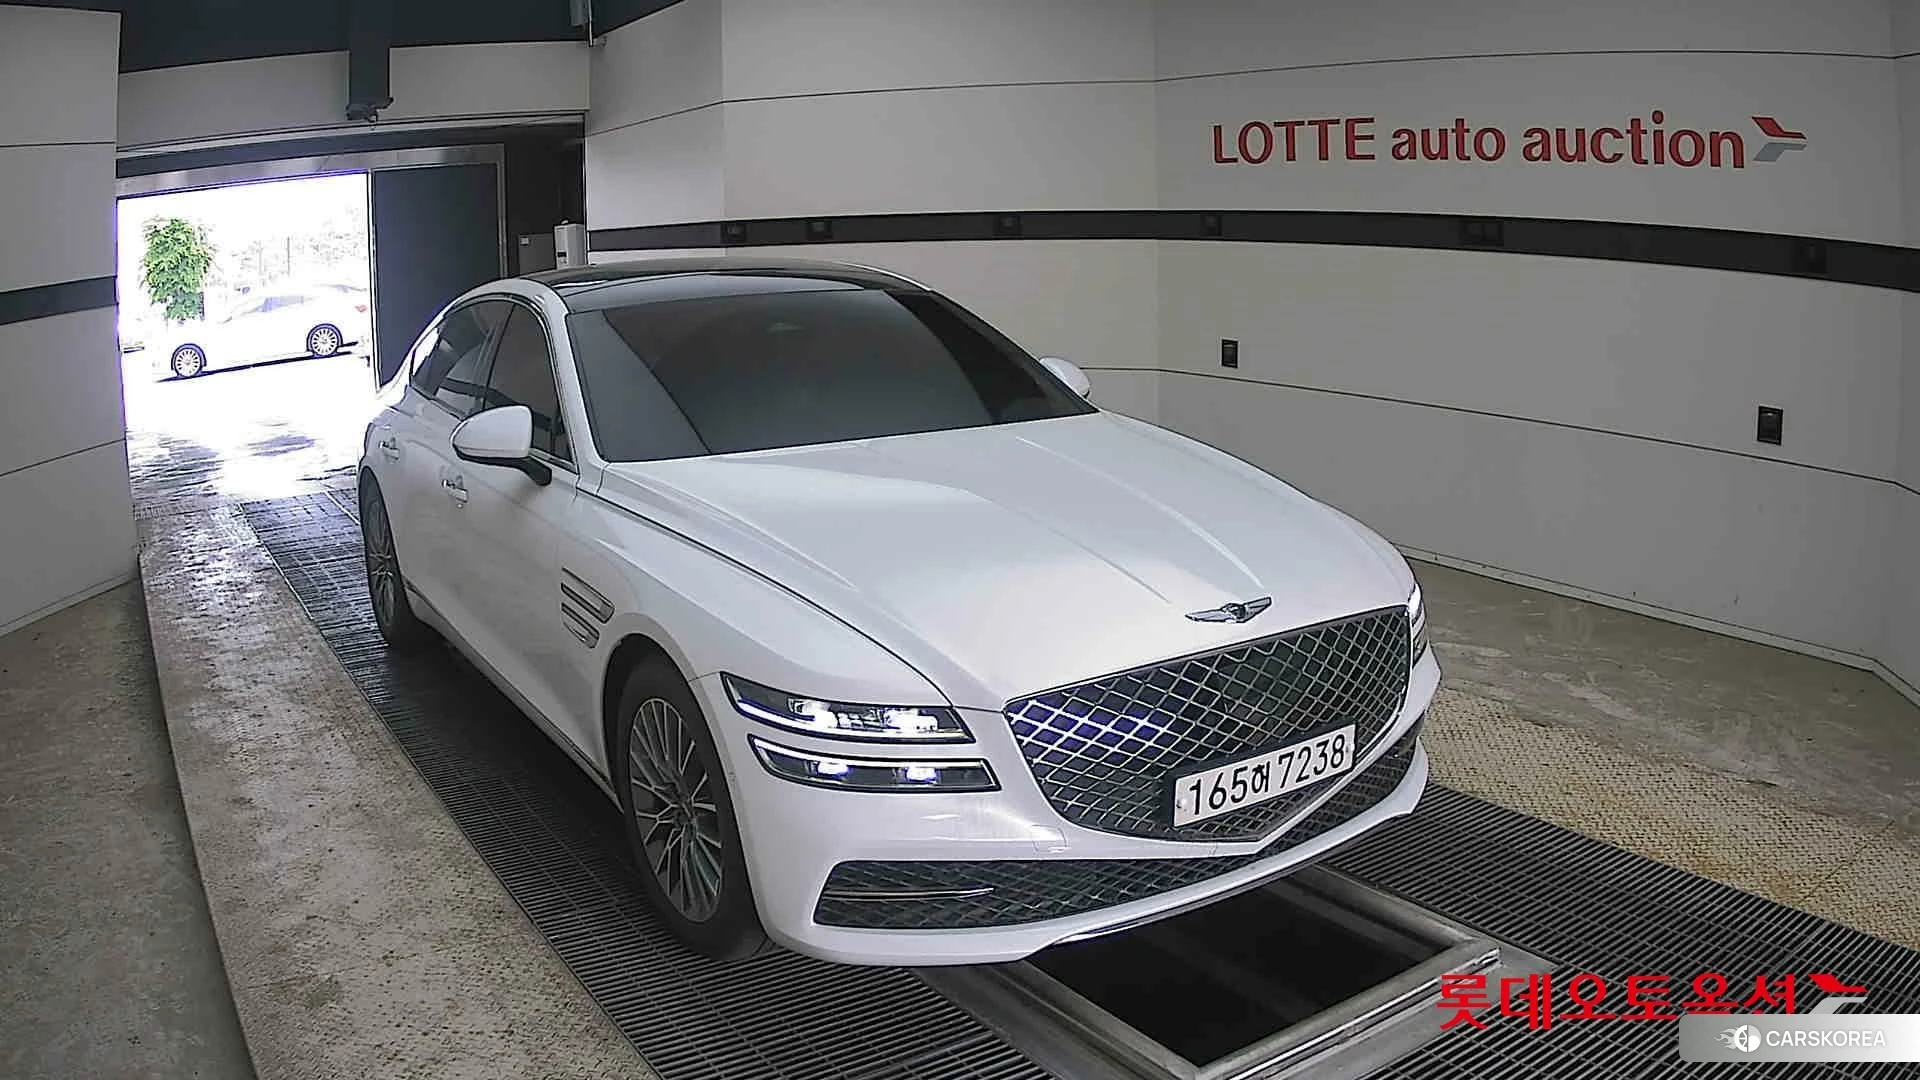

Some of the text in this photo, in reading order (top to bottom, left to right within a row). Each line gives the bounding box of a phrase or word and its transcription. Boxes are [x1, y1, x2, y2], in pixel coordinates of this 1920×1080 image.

[1213, 110, 1745, 169] LOTTE auto auction
[1278, 734, 1345, 789] 7238
